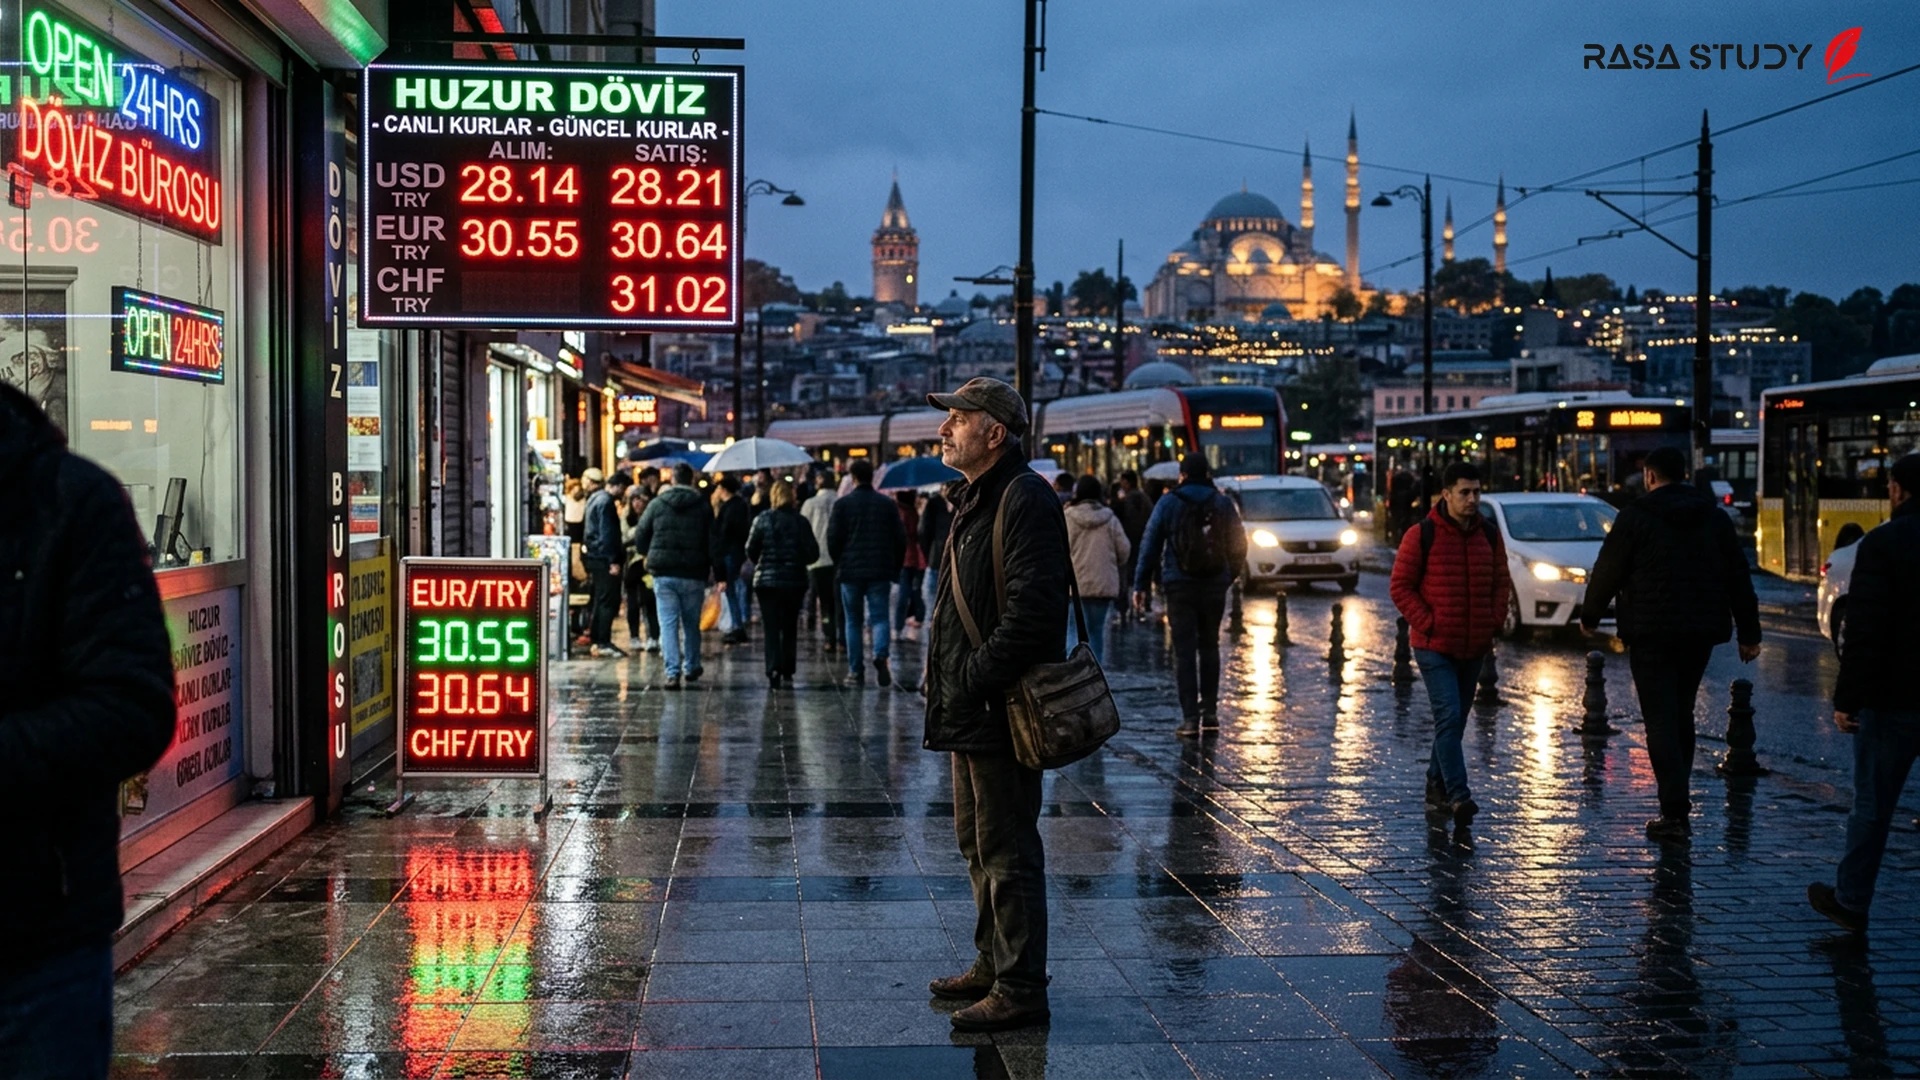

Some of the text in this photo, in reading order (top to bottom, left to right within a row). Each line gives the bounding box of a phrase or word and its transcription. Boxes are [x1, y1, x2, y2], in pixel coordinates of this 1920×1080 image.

[28, 11, 201, 149] OPEN 24HRS
[396, 76, 706, 115] HUZUR DÖVİZ
[384, 115, 444, 134] CANLI
[450, 116, 532, 136] KURLAR
[549, 115, 632, 138] GÜNCEL
[636, 120, 718, 140] KURLAR
[21, 96, 220, 230] DÖVİZ BÜROSU
[489, 141, 707, 167] ALIM: SATIŞ:
[376, 162, 723, 206] USD 28.14 28.21
[391, 192, 431, 208] TRY
[376, 215, 727, 260] EUR 30.55 30.64
[391, 245, 431, 260] TRY
[376, 266, 727, 313] CHF 31.02
[391, 297, 431, 313] TRY
[127, 306, 222, 369] OPEN 24HRS
[328, 161, 346, 759] DÖVİZ BÜROSU
[412, 578, 534, 608] EUR/TRY
[418, 620, 530, 662] 30.55
[418, 673, 530, 714] 30.64
[411, 729, 533, 758] CHF/TRY
